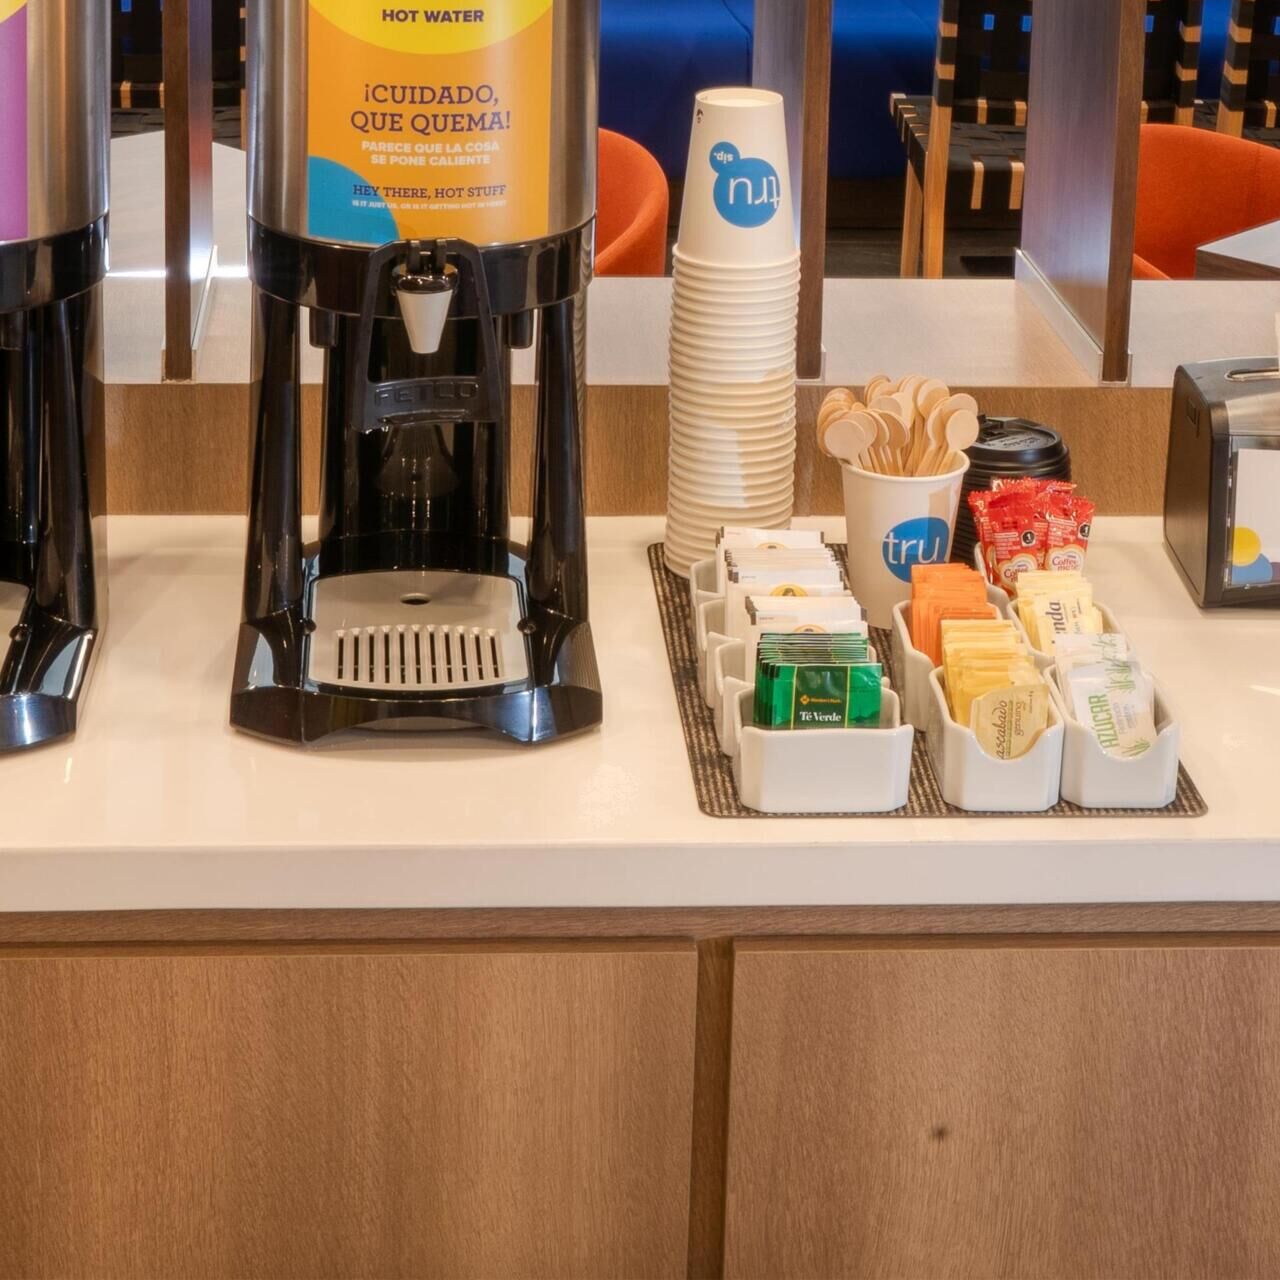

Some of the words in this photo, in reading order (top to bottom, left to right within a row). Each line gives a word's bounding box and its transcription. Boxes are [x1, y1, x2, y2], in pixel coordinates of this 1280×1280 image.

[381, 9, 419, 22] HOT
[423, 9, 484, 23] WATER
[364, 83, 499, 106] ¡CUIDADO,
[350, 110, 403, 133] QUE
[410, 110, 511, 136] QUEMA!
[361, 140, 411, 153] PARECE
[414, 142, 442, 153] QUE
[446, 142, 463, 153] LA
[465, 140, 500, 153] COSA
[371, 154, 386, 165] SE
[389, 155, 426, 166] PONE
[429, 154, 491, 166] CALIENTE
[352, 184, 379, 198] HEY
[383, 187, 431, 200] THERE,
[434, 188, 464, 199] HOT
[467, 185, 507, 198] STUFF
[728, 176, 780, 209] tru
[883, 532, 940, 564] tru
[799, 711, 812, 721] Té
[813, 711, 842, 722] Verde
[1088, 693, 1119, 749] AZÚCAR
[991, 699, 1008, 759] ascabado
